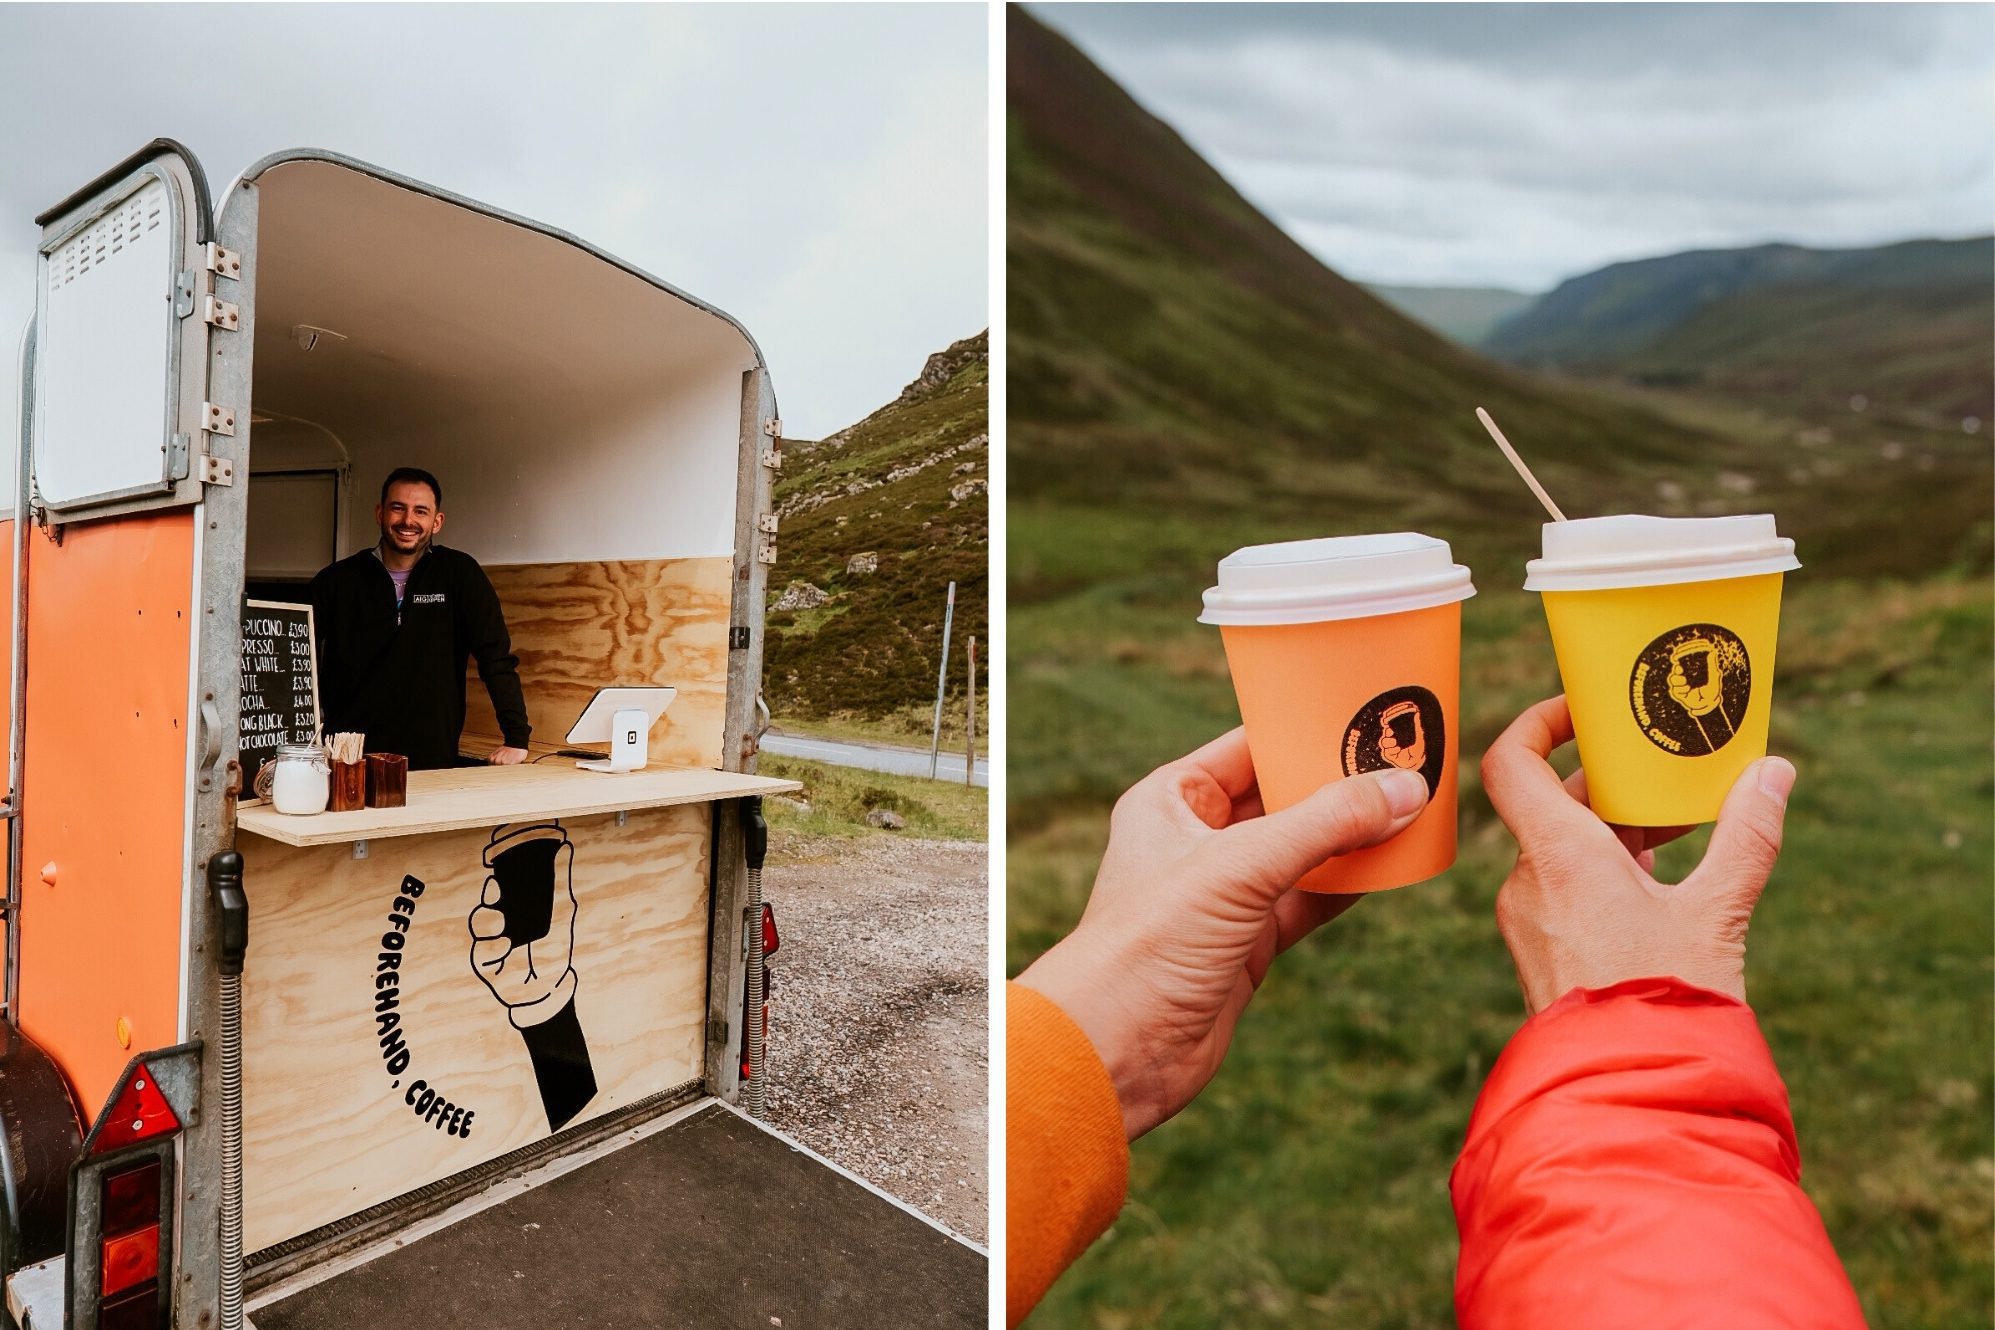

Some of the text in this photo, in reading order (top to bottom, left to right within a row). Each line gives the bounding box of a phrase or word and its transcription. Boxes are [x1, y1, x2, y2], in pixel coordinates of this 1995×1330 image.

[243, 619, 308, 638] PUCCINO... £3.90
[241, 639, 310, 655] PRESSO... £3.00
[241, 658, 250, 672] AT
[292, 658, 311, 672] £3.90
[240, 674, 312, 692] ATTE... £3.90
[240, 695, 312, 712] OCHA... £4.00
[240, 715, 256, 731] ONG
[295, 713, 315, 727] £3.20
[295, 730, 314, 742] £3.00
[1649, 728, 1681, 752] COFFEE
[405, 1079, 475, 1139] COFFEE
